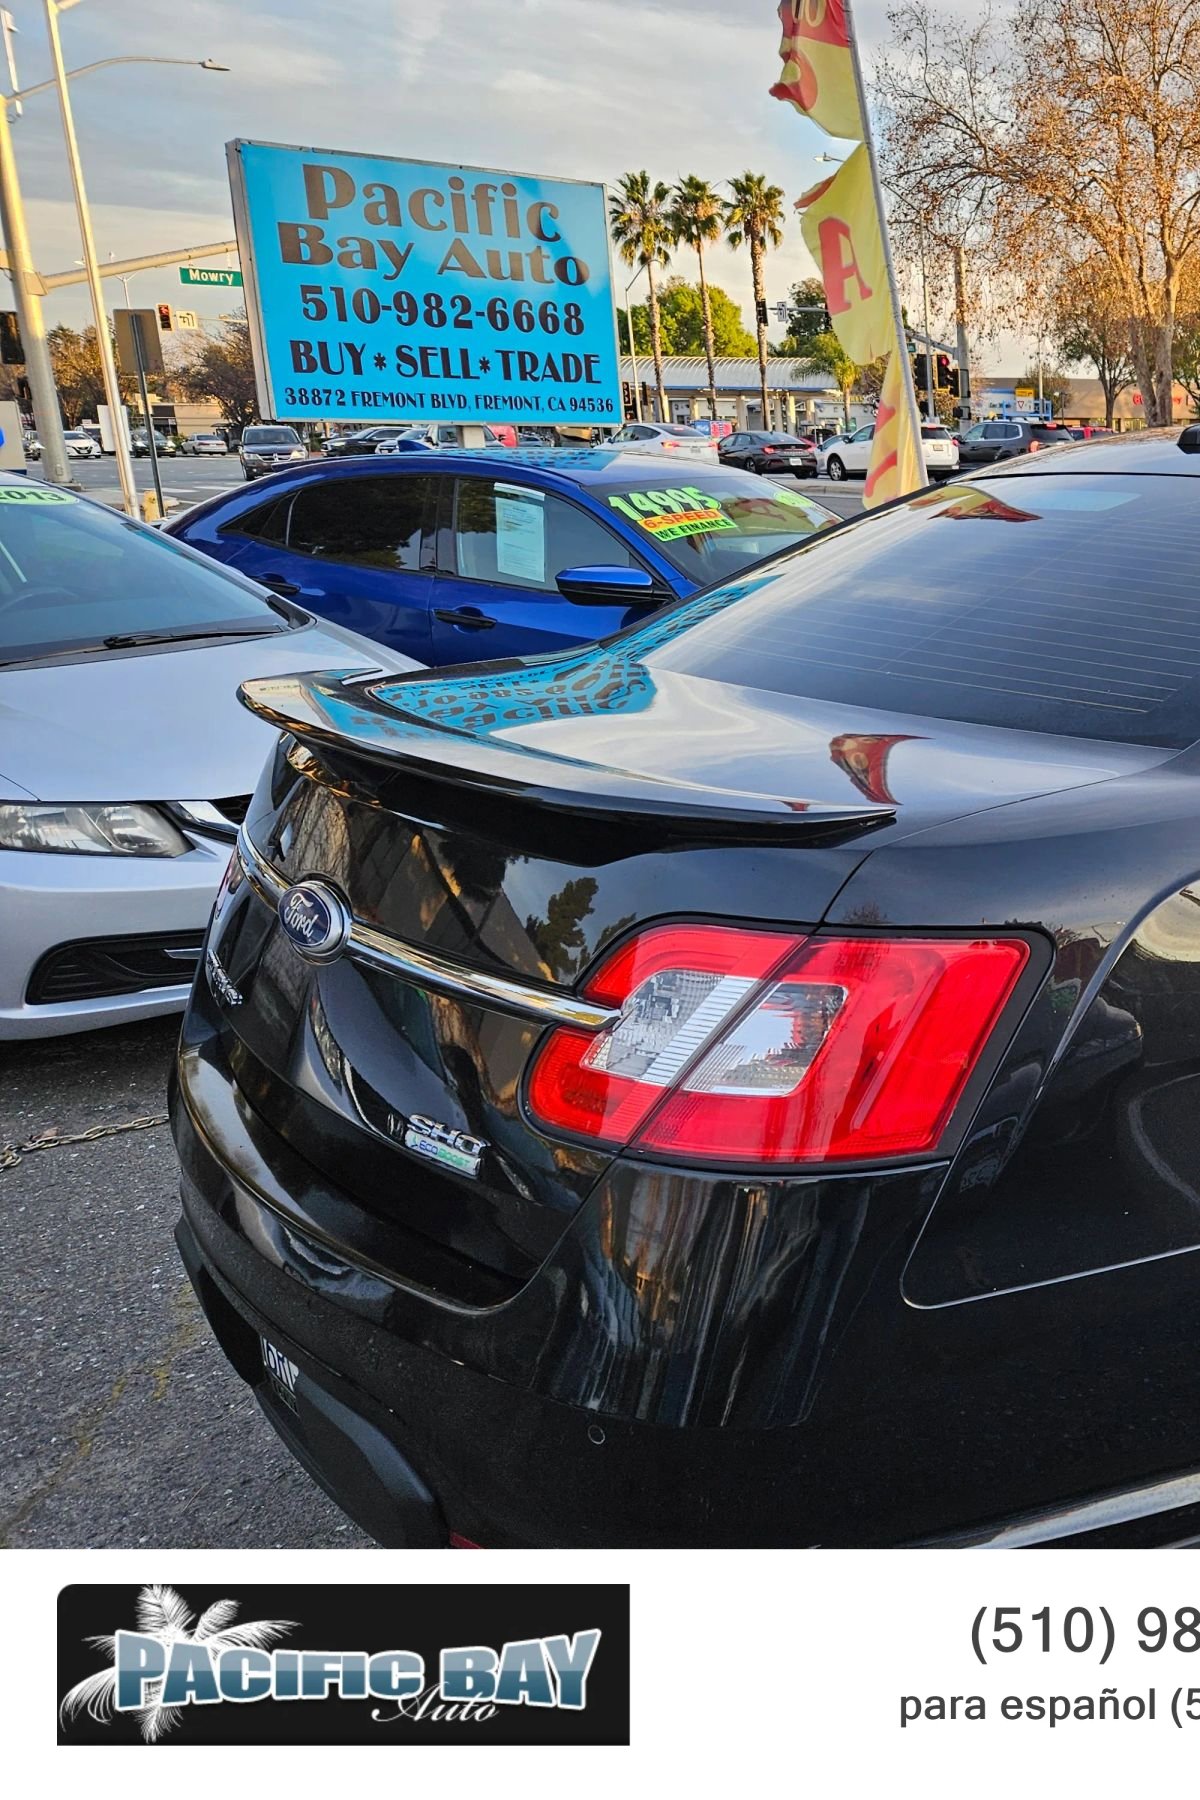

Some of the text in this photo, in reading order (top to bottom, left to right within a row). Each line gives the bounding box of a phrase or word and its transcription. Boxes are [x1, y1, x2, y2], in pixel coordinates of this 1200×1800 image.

[302, 163, 561, 242] Pacific
[277, 221, 590, 286] Bay Auto
[188, 268, 234, 286] Mowry
[301, 285, 585, 336] 510-982-6668
[289, 340, 602, 384] BUY SELL TRADE
[284, 387, 614, 414] 38872 FREMONT BLVD, FREMONT, CA 94536
[608, 486, 721, 522] 14995
[643, 509, 720, 530] 6-SPEED
[655, 518, 732, 541] WE FINANCE
[284, 892, 320, 938] Ford
[406, 1113, 484, 1158] SHO
